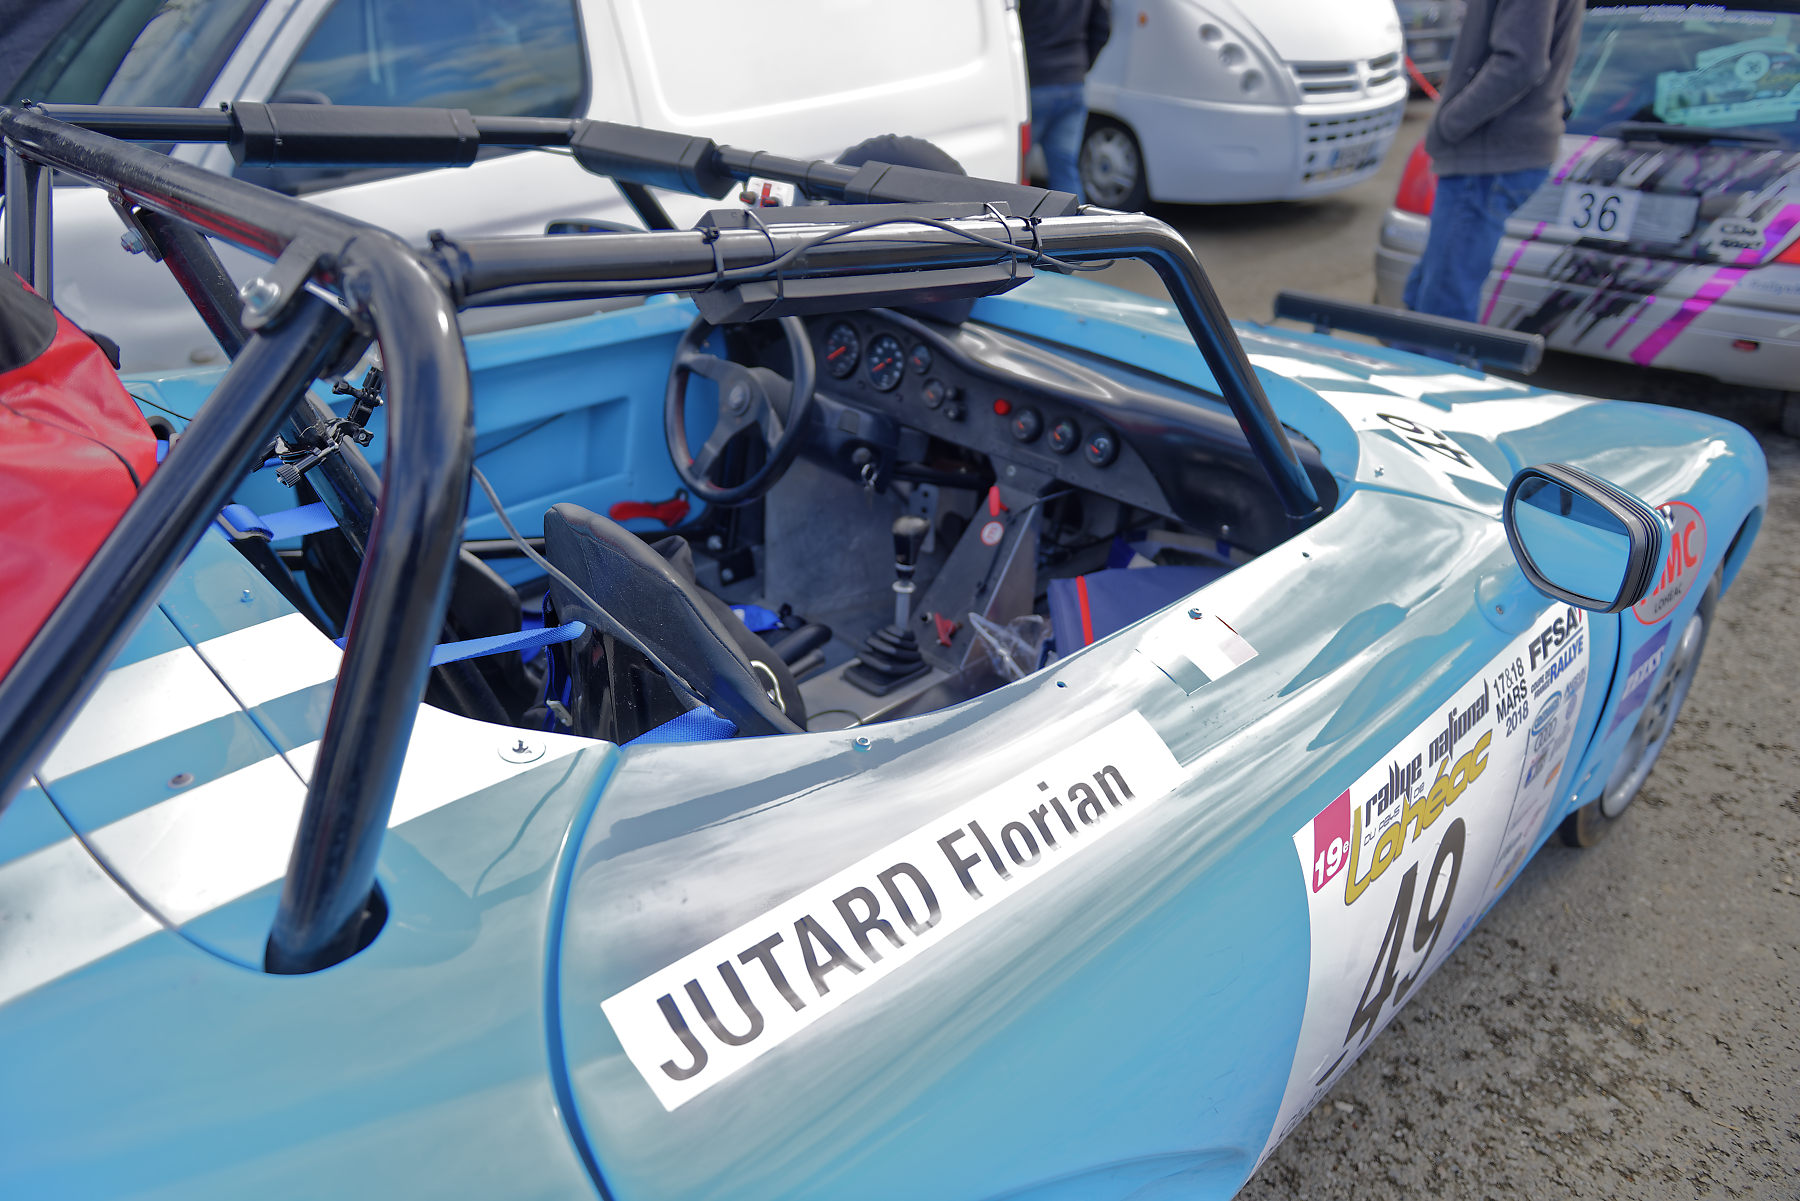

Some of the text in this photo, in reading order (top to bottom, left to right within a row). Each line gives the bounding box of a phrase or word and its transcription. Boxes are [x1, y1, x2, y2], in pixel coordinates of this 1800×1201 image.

[1572, 192, 1621, 232] 36
[1641, 520, 1698, 605] MC
[1528, 605, 1579, 672] FFSA
[1550, 634, 1584, 684] RALLYE
[1493, 656, 1525, 698] 17&18
[1496, 678, 1528, 724] MARS
[1505, 700, 1529, 738] 2018
[1365, 678, 1490, 828] rallye national
[1344, 728, 1493, 906] Lohéac
[656, 763, 1137, 1082] JUTARD Florian
[1343, 816, 1467, 1048] 49
